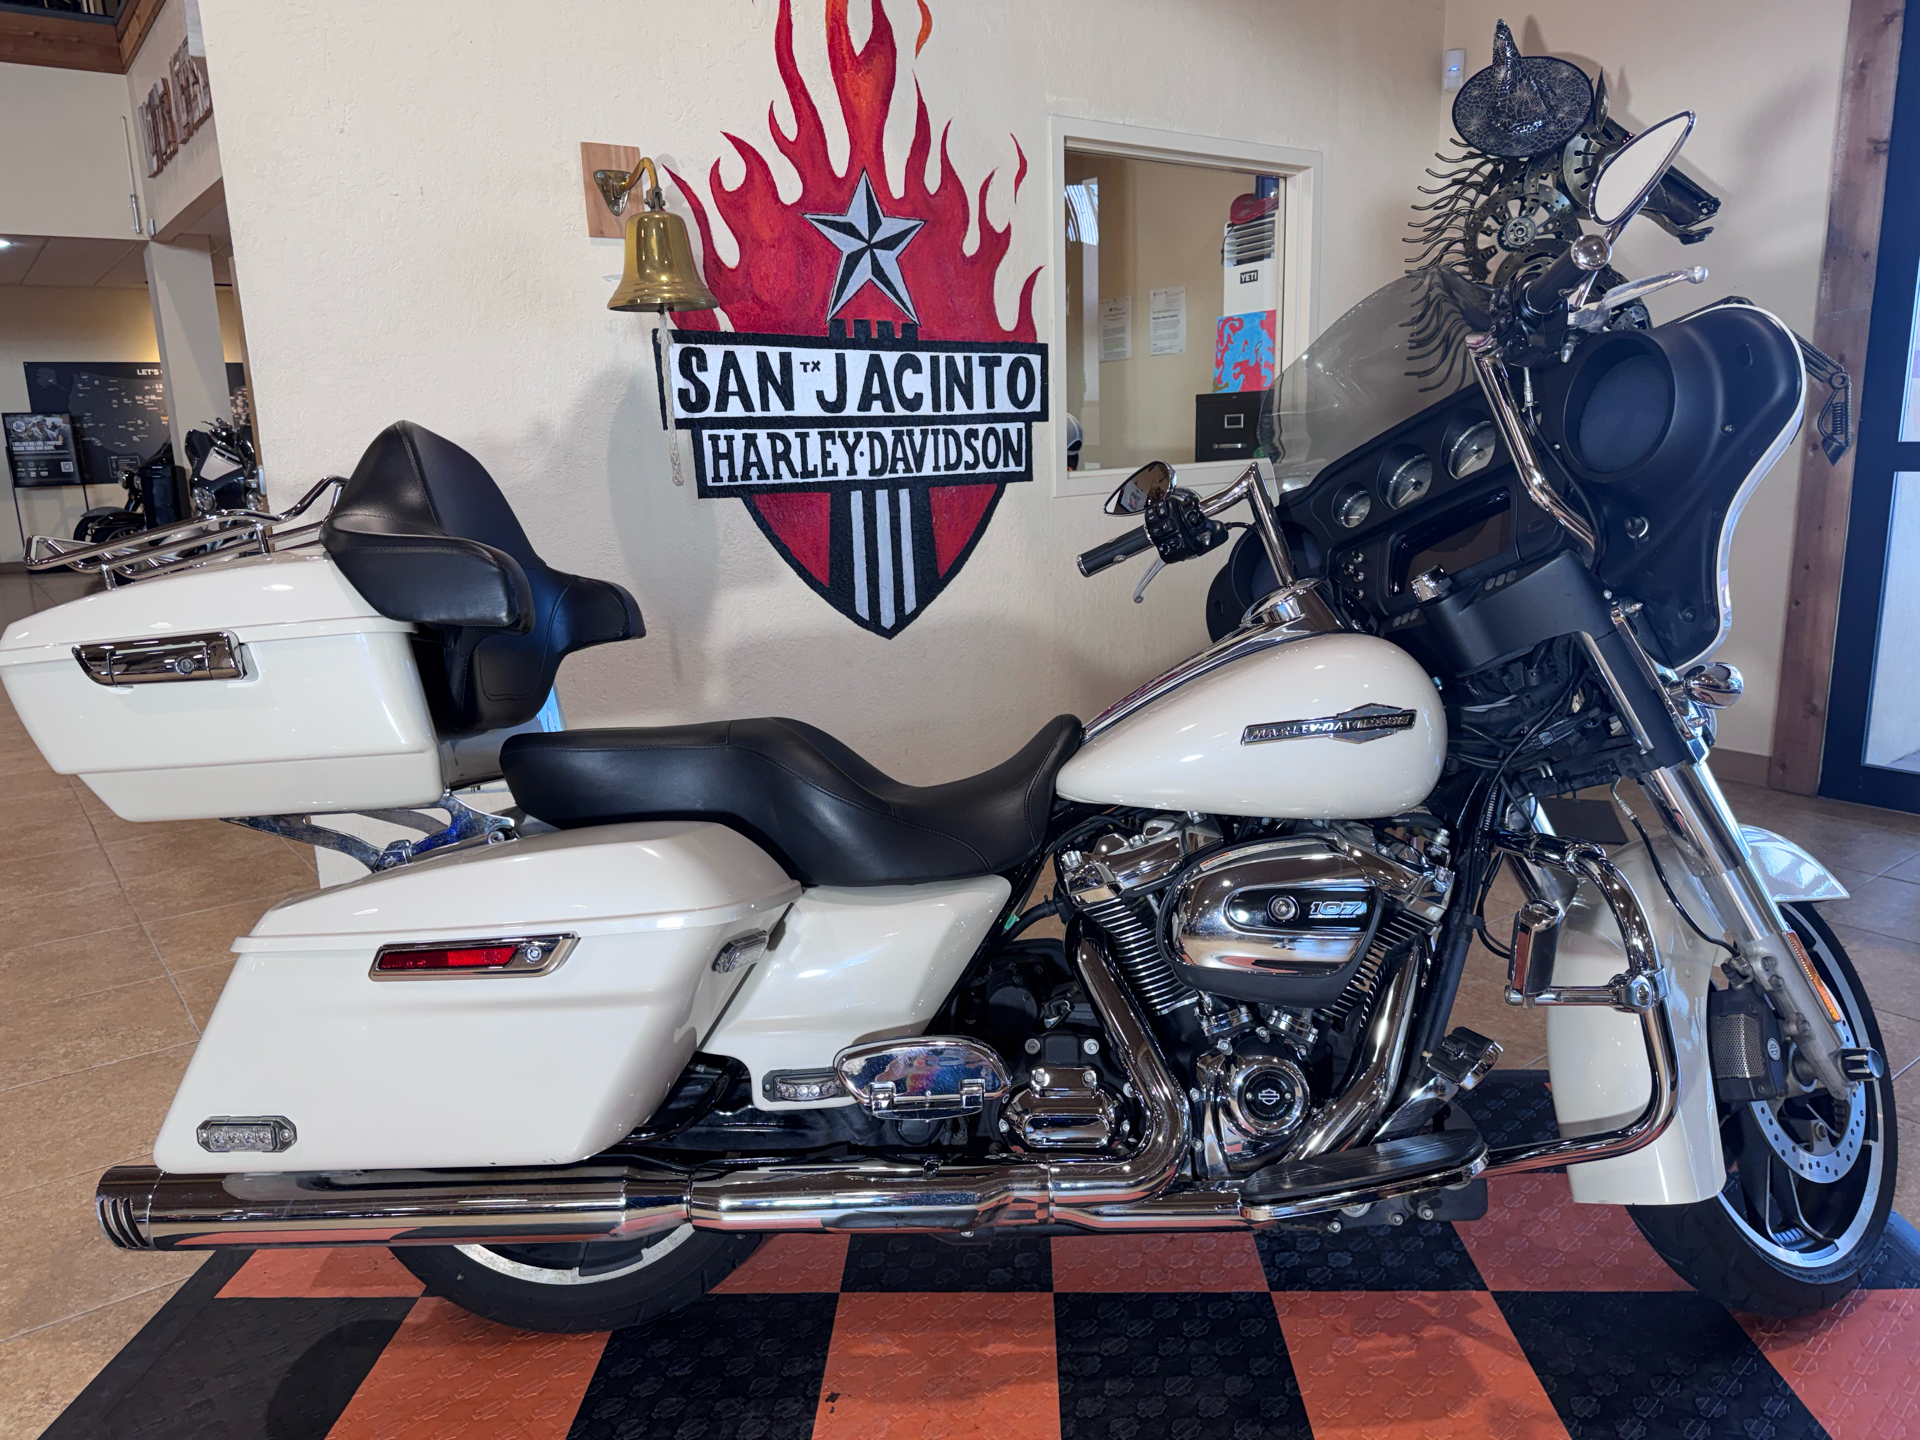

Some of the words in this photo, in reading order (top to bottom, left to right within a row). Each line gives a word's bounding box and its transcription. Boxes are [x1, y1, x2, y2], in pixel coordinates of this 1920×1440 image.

[1241, 272, 1258, 283] YETI
[136, 368, 160, 376] LET'S
[678, 346, 795, 413] SAN
[800, 360, 821, 373] TX
[815, 353, 1036, 414] JACINTO
[1309, 901, 1362, 915] 107
